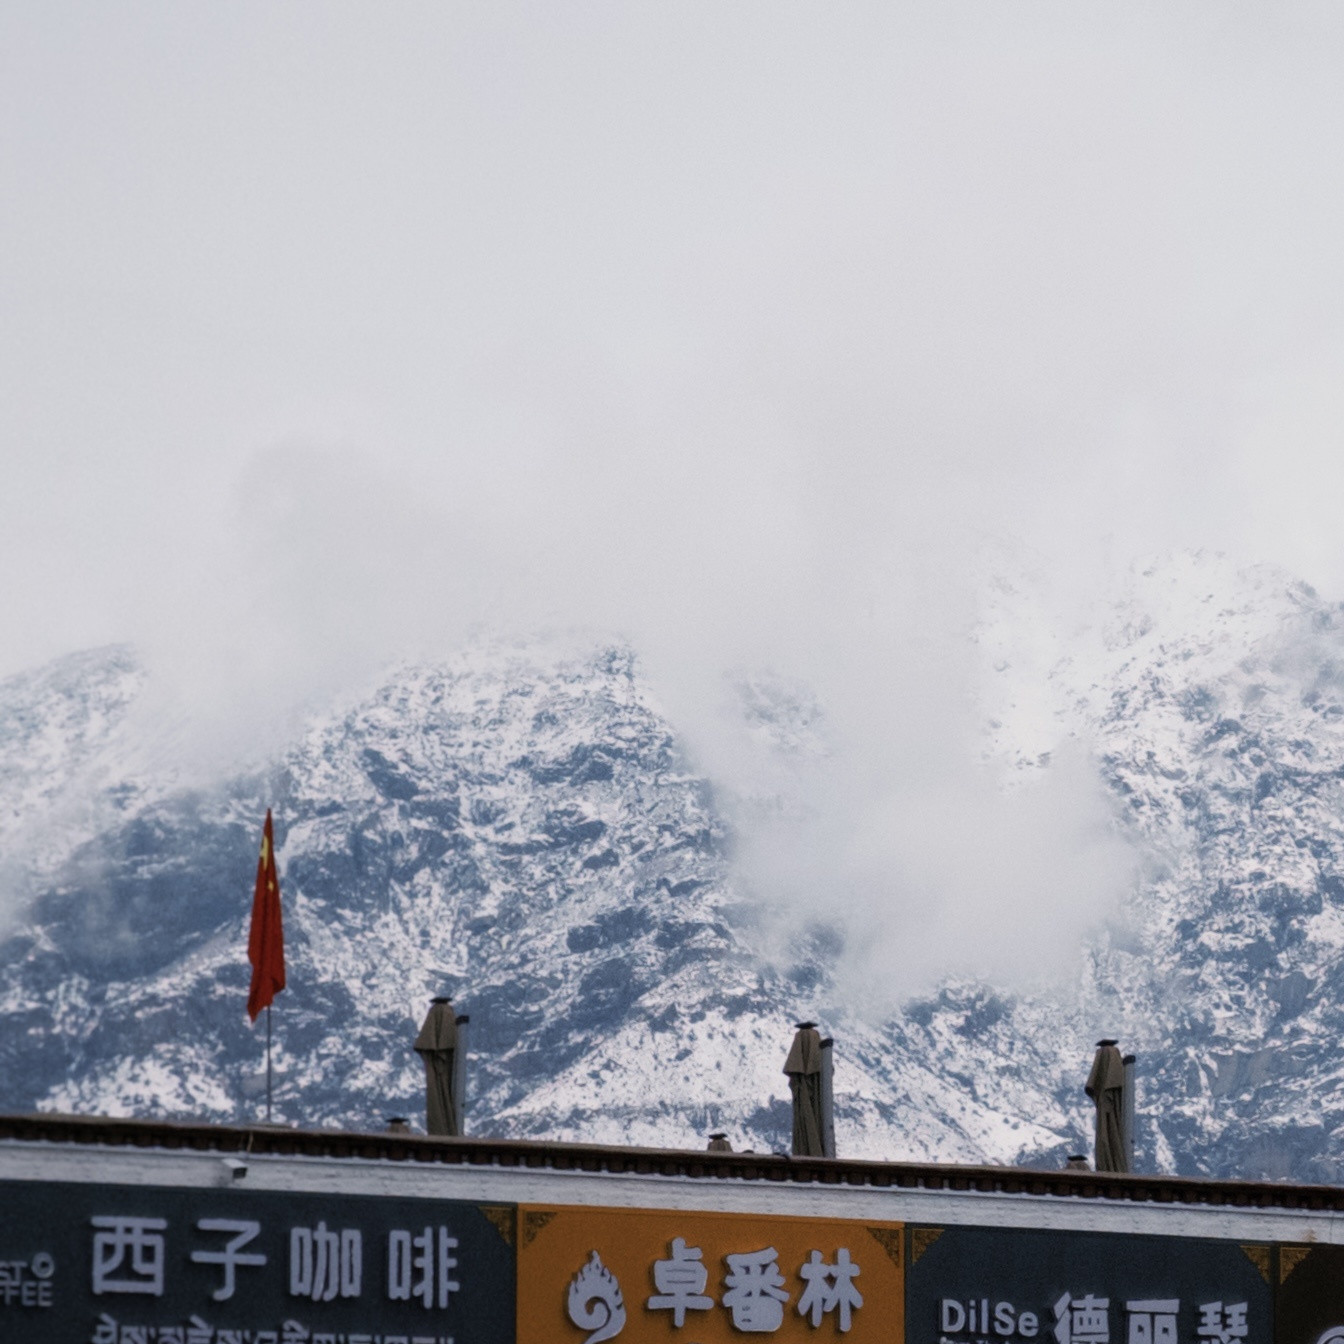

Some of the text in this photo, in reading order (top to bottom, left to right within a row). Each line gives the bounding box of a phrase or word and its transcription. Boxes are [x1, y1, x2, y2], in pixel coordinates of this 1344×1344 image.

[91, 1216, 460, 1308] 西子咖啡
[648, 1237, 863, 1332] 卓番林
